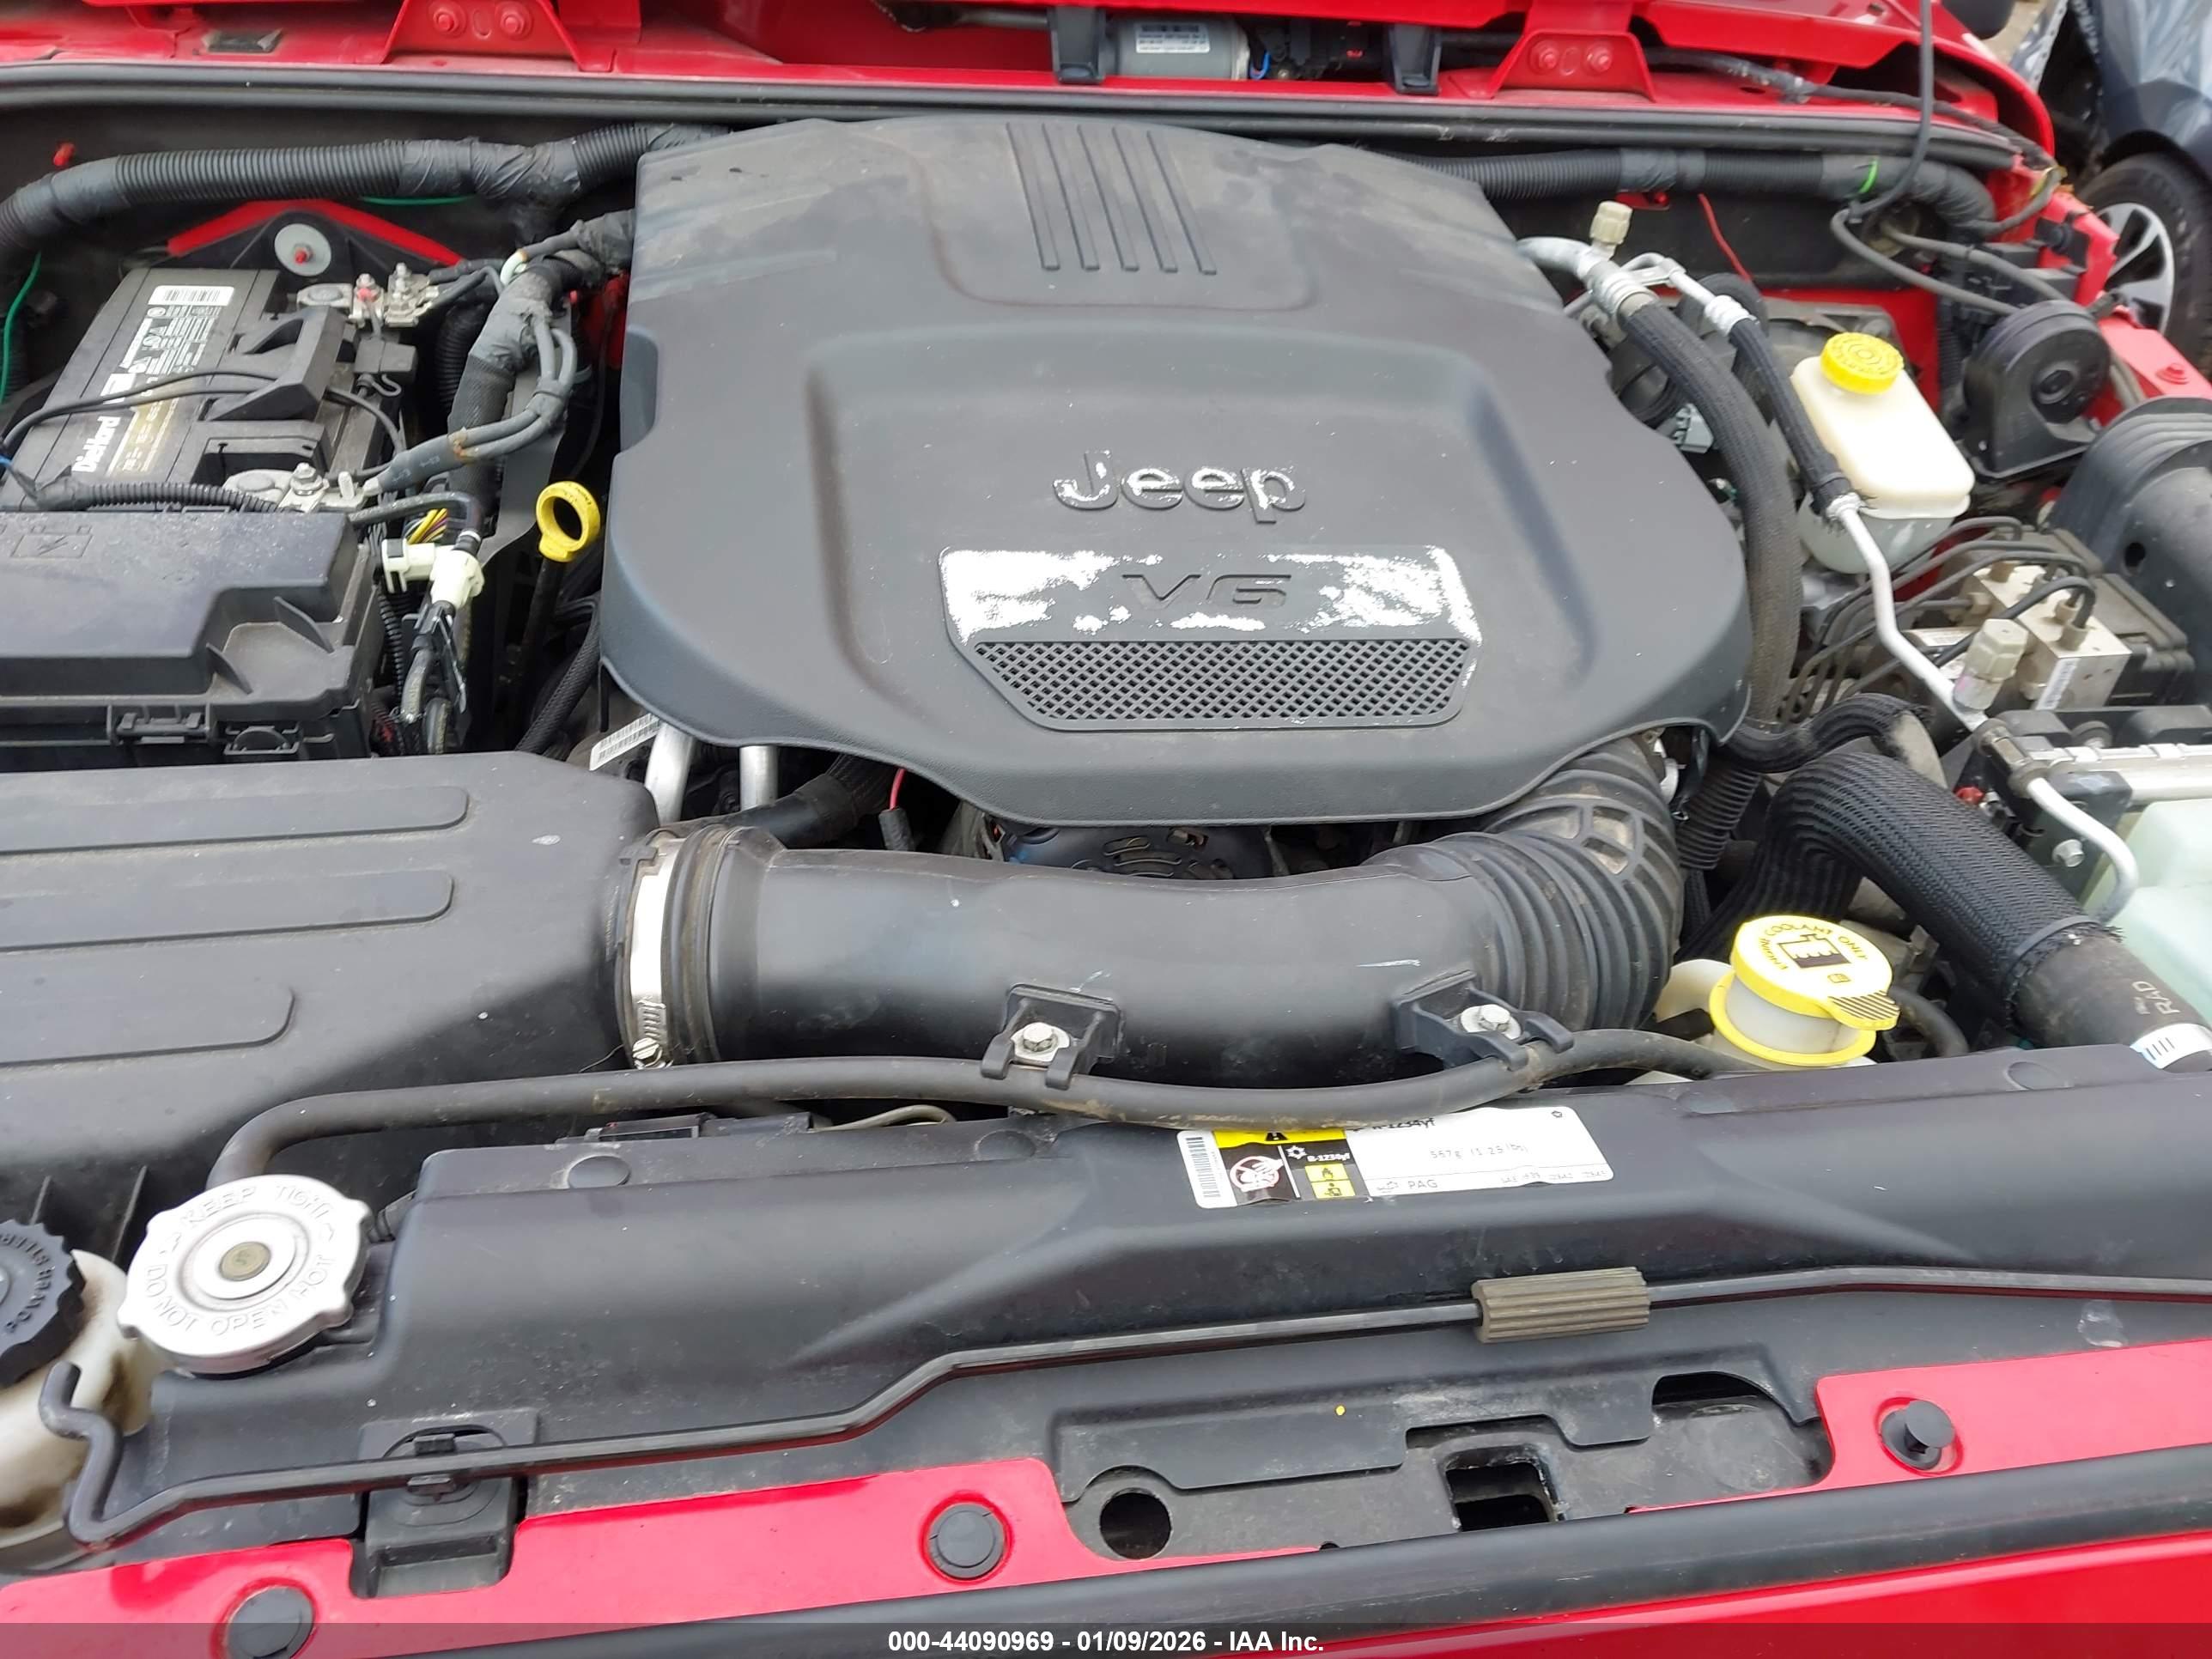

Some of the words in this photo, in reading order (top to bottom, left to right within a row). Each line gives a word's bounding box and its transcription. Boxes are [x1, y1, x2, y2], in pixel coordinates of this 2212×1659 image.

[1053, 449, 1305, 524] Jeep
[1122, 573, 1291, 609] V6
[1838, 935, 1869, 960] ONLY
[2131, 981, 2181, 1014] RAD
[1408, 1179, 1438, 1188] PAG
[180, 1185, 257, 1227] KEEP
[276, 1183, 332, 1218] TIGHT
[146, 1264, 168, 1298] DO
[289, 1254, 334, 1299] HOT
[155, 1297, 200, 1332] NOT
[210, 1303, 289, 1336] OPEN
